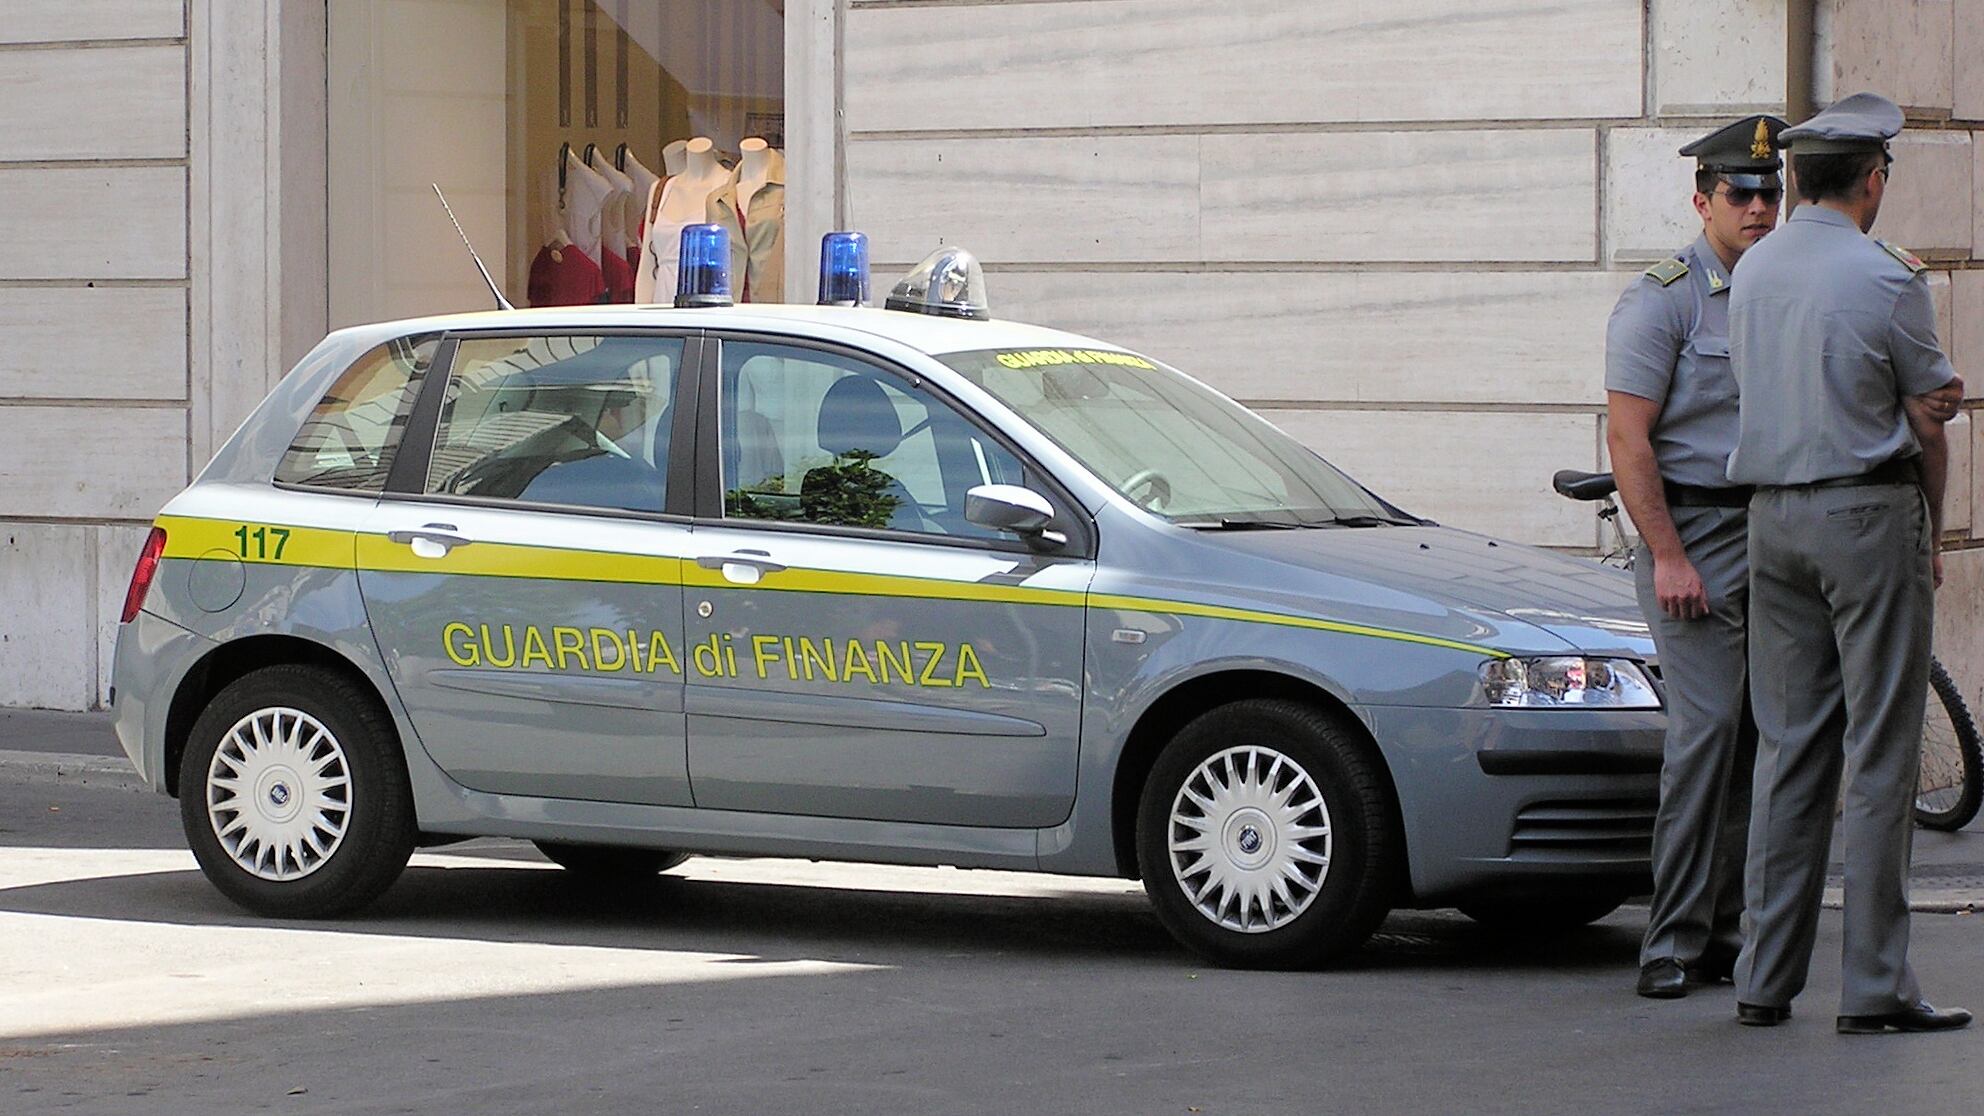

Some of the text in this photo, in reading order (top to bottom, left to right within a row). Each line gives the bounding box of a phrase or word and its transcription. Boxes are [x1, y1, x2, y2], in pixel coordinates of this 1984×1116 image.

[996, 350, 1079, 369] GUARDIA
[234, 525, 291, 560] 117
[442, 621, 992, 689] GUARDIA di FINANZA
